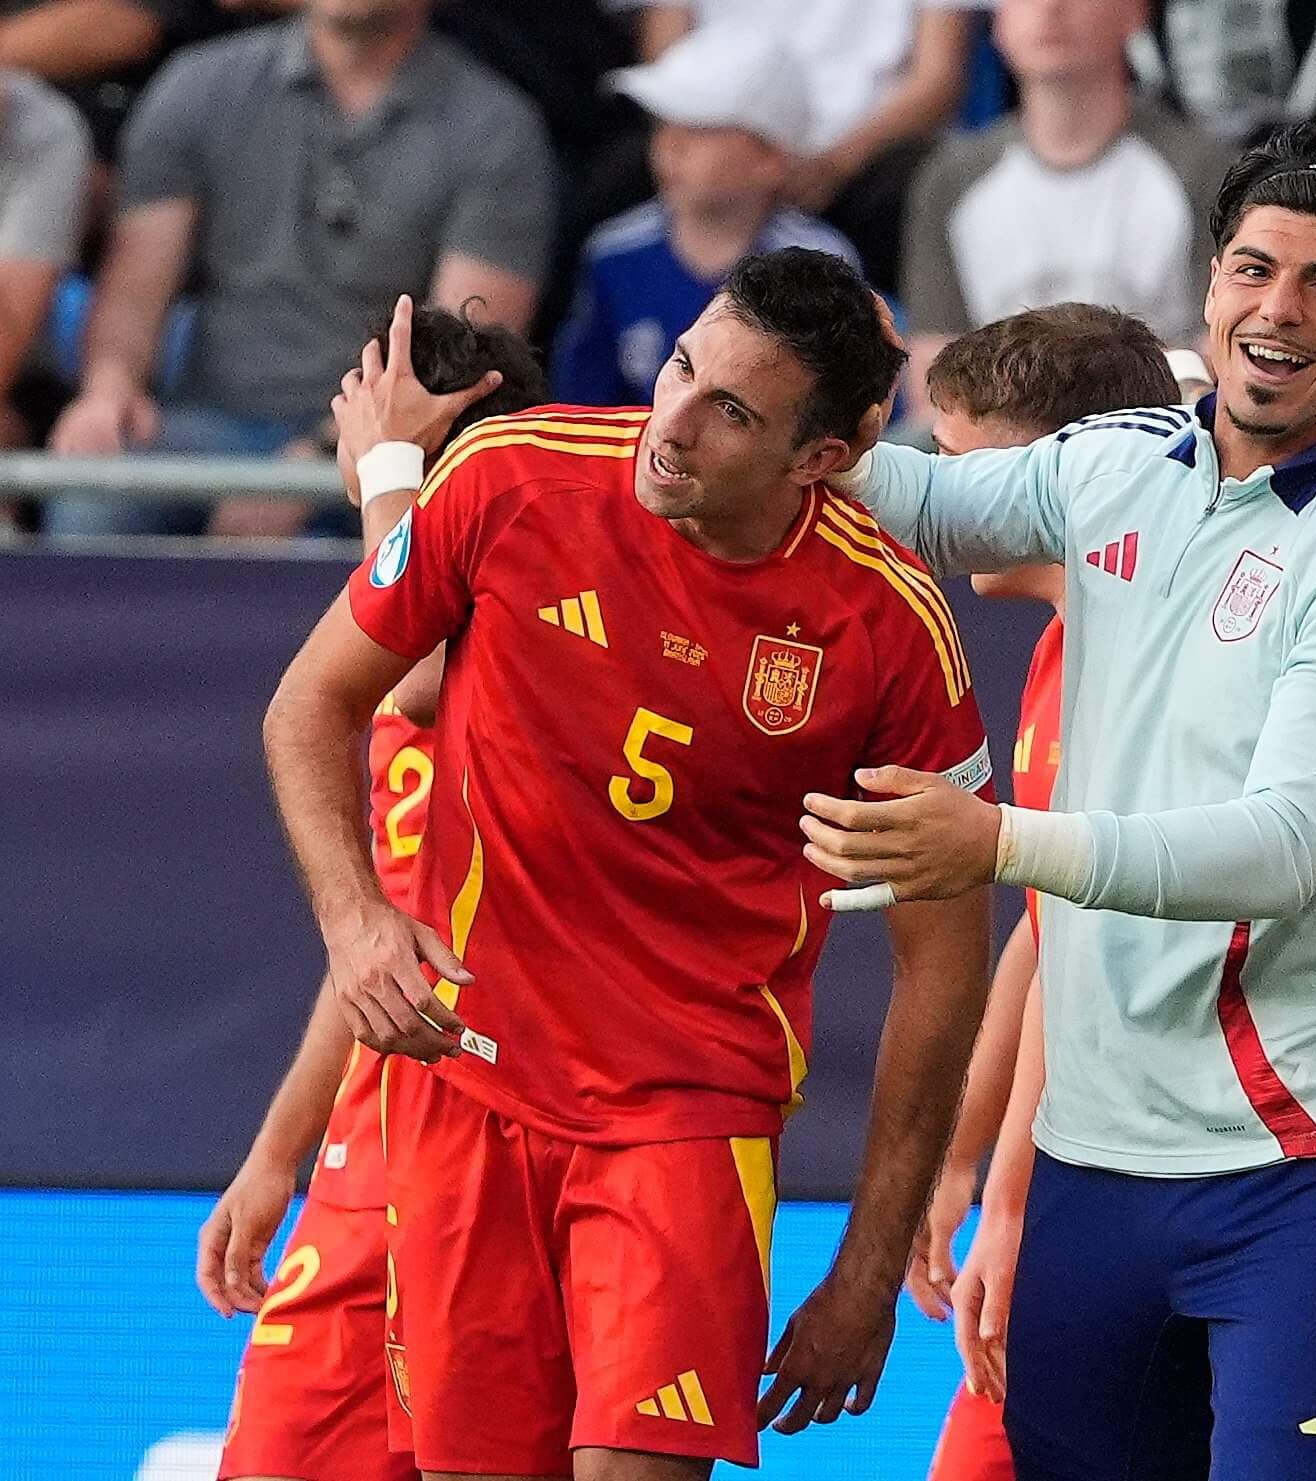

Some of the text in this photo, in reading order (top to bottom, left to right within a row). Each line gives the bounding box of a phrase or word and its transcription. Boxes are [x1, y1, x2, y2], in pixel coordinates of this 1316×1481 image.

[386, 746, 434, 859] 2
[608, 707, 694, 821] 5
[252, 1244, 321, 1345] 2
